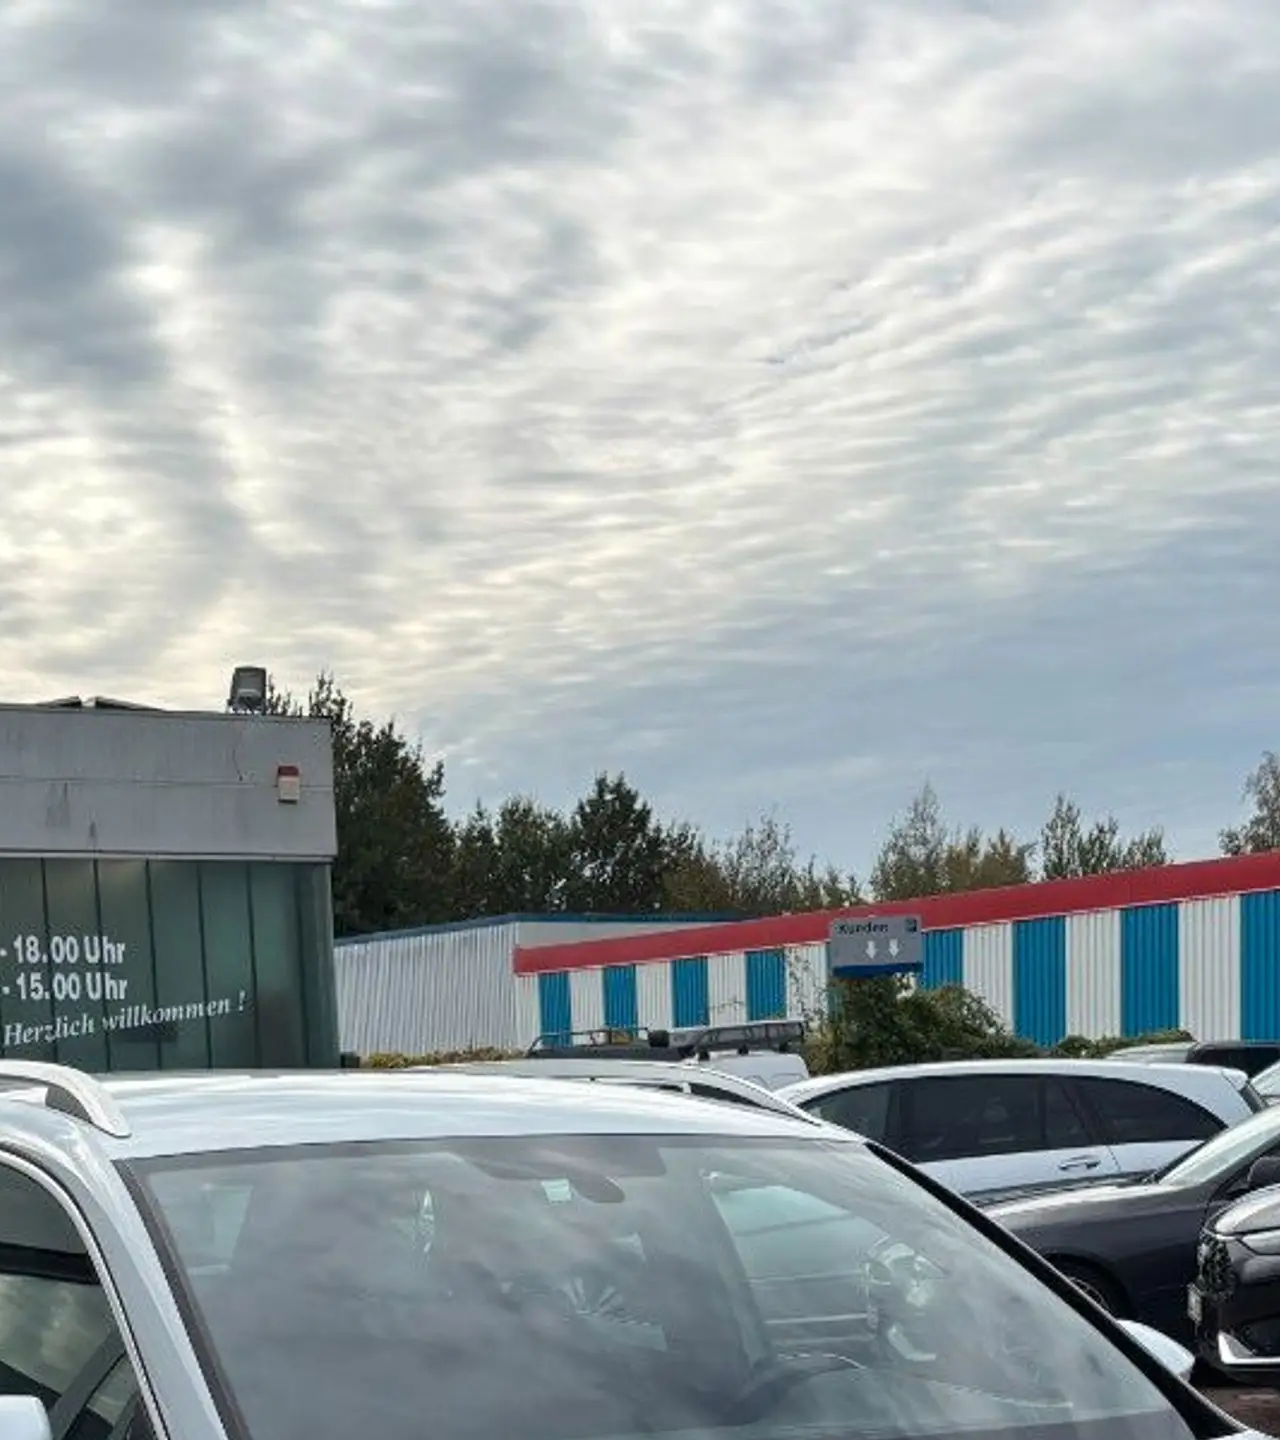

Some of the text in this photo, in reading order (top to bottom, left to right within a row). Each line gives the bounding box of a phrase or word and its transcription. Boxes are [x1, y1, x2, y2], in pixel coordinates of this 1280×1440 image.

[14, 935, 80, 964] 18.00
[84, 935, 126, 963] Uhr
[17, 972, 81, 1001] 15.00
[86, 972, 128, 1001] Uhr
[3, 1012, 95, 1047] Herzlich
[101, 998, 231, 1031] willkommen
